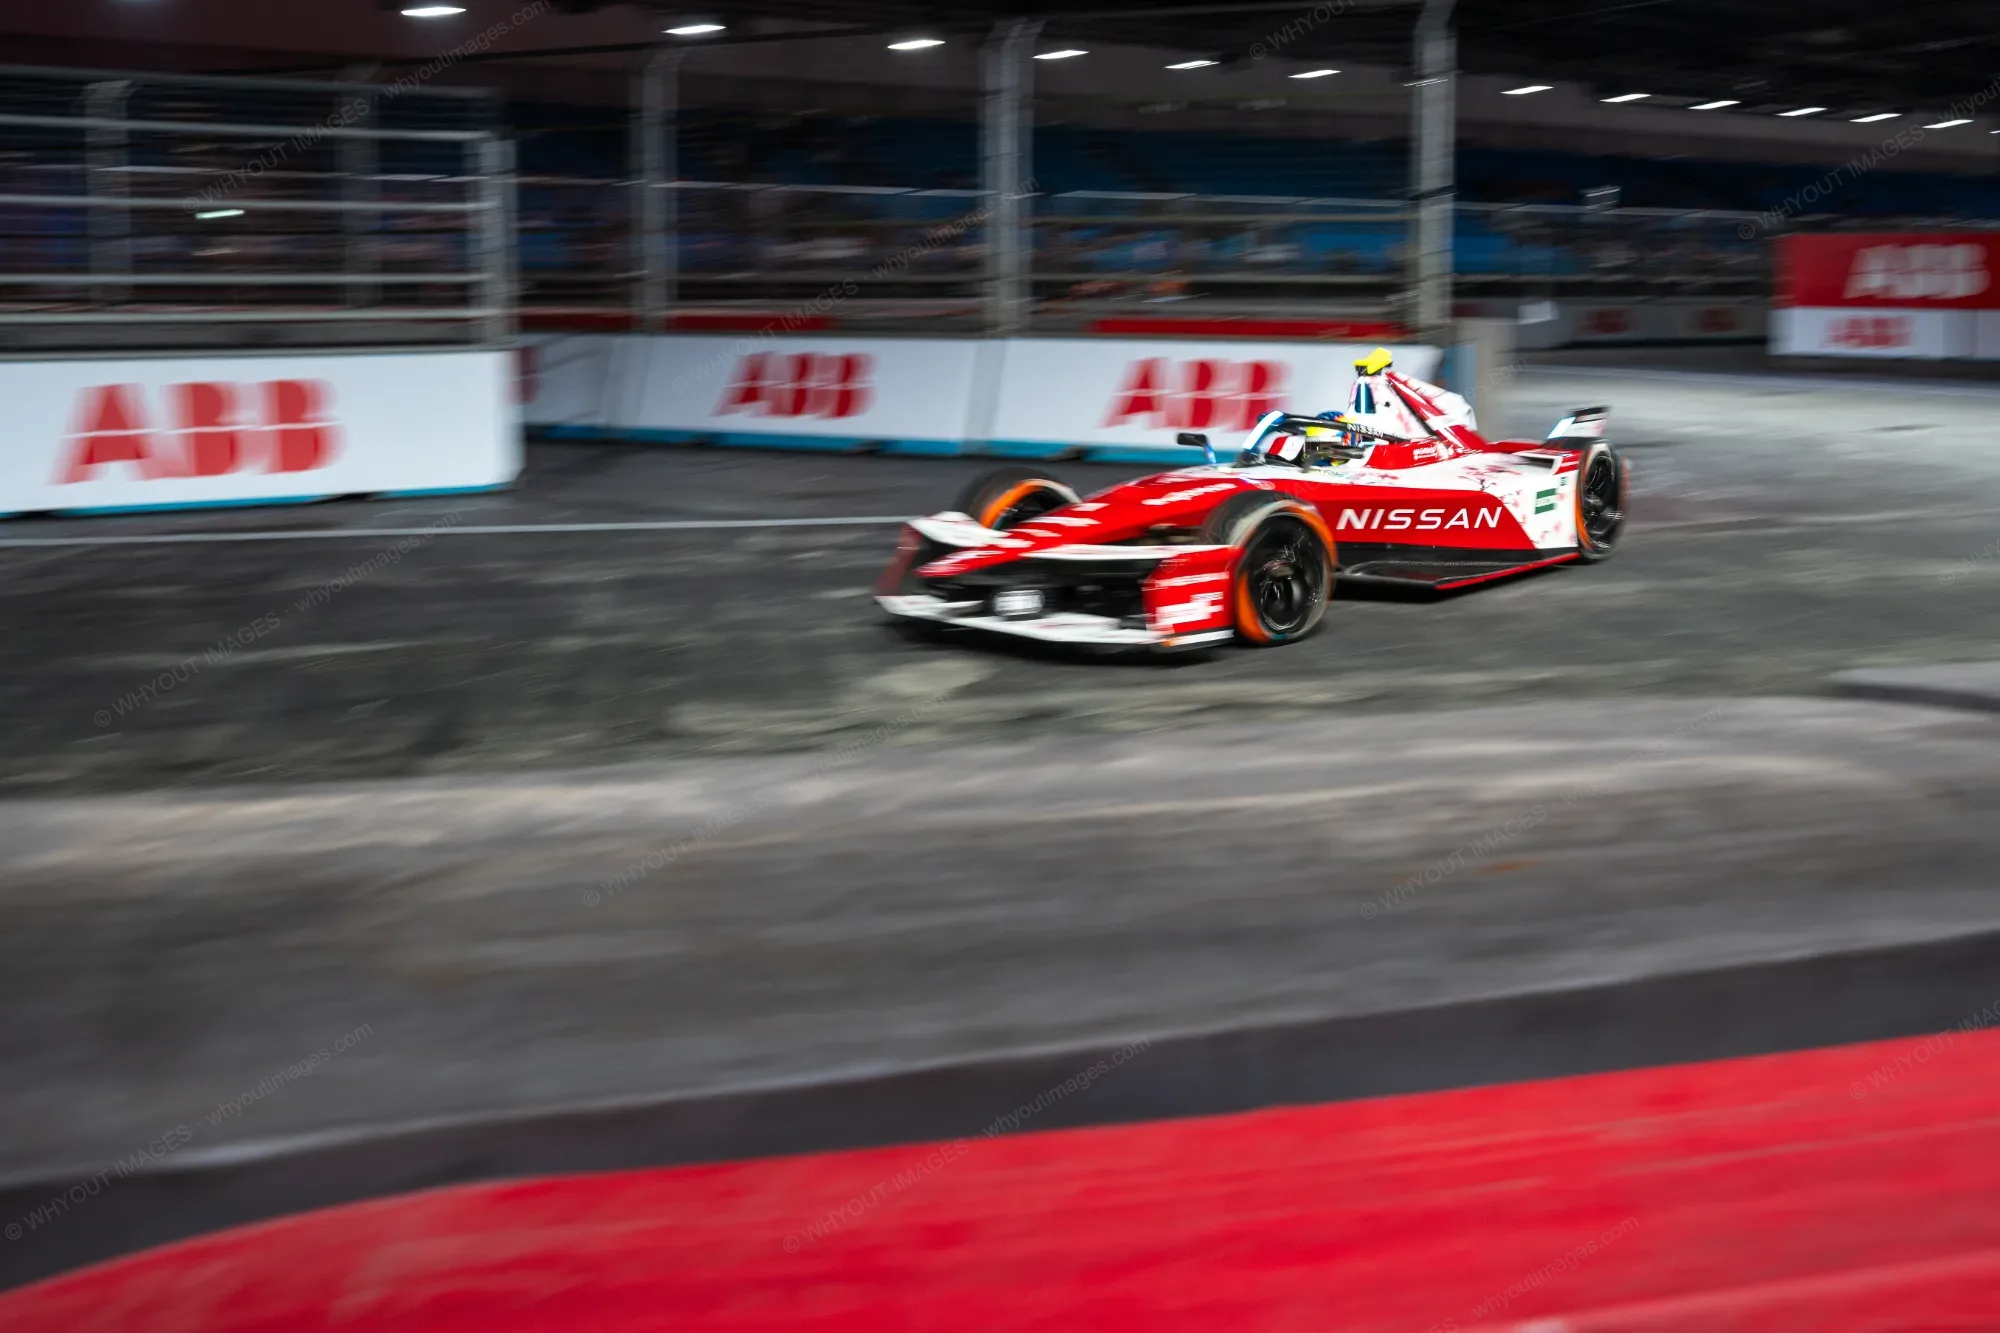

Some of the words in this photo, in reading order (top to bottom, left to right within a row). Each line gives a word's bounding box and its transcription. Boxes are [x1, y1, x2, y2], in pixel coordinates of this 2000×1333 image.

[1844, 243, 1989, 299] ABB
[714, 351, 873, 418] ABB
[1103, 357, 1289, 431] ABB
[54, 378, 343, 486] ABB
[1347, 423, 1384, 438] NISSAN
[1337, 507, 1502, 530] NISSAN
